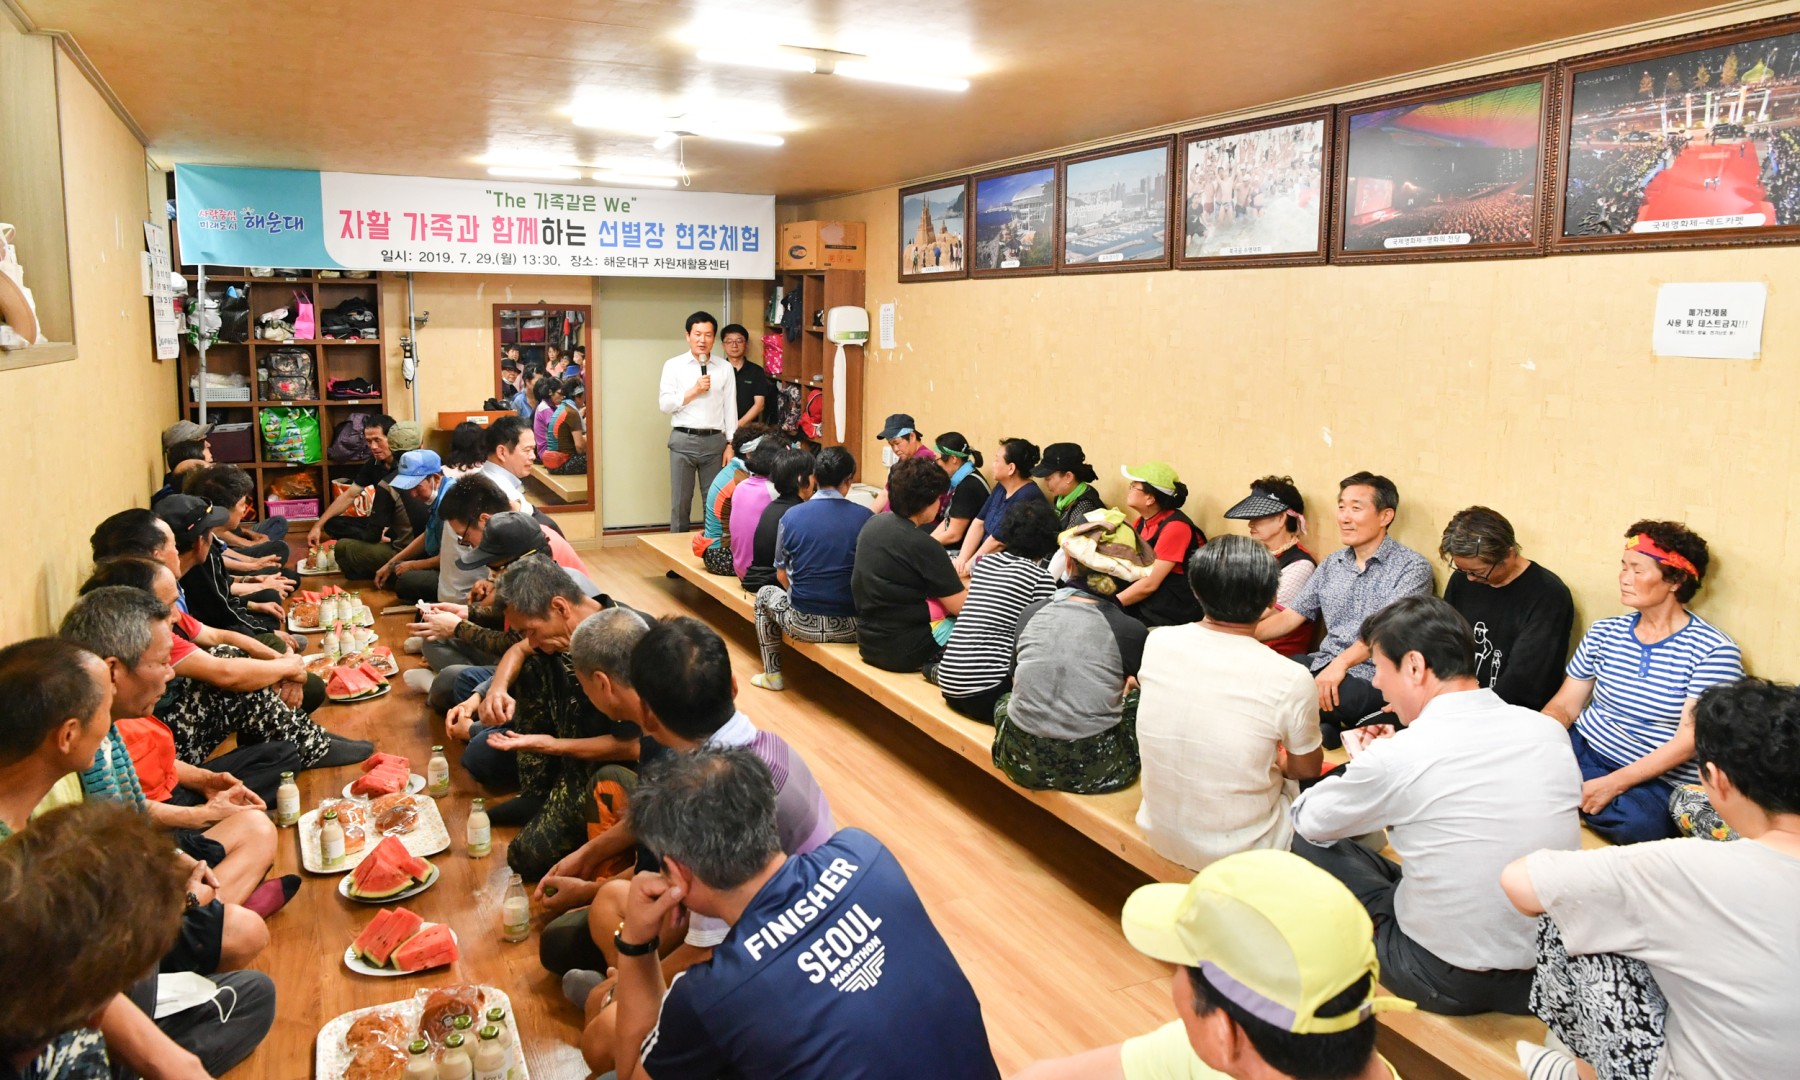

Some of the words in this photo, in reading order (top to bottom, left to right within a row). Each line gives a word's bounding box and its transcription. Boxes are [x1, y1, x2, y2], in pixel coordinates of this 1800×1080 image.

[486, 190, 526, 208] "The
[534, 192, 596, 212] 가족같은
[604, 196, 637, 213] We"
[198, 208, 237, 221] 사람중심
[199, 220, 237, 230] 미래도시
[243, 211, 304, 234] 해운대
[339, 210, 391, 240] 자활
[403, 212, 480, 243] 가족과
[492, 215, 587, 246] 함께하는
[598, 220, 665, 249] 선별장
[675, 222, 759, 252] 현장체험
[381, 250, 412, 262] 일시:
[419, 251, 454, 264] 2019.
[459, 252, 471, 264] 7.
[522, 254, 561, 267] 13:30.
[570, 255, 598, 267] 장소:
[603, 256, 650, 269] 해운대구
[653, 258, 730, 271] 자원재활용센터
[1666, 319, 1682, 328] 사용
[743, 857, 859, 962] FINISHER
[797, 903, 883, 984] SEOUL
[829, 935, 882, 988] MARATHON
